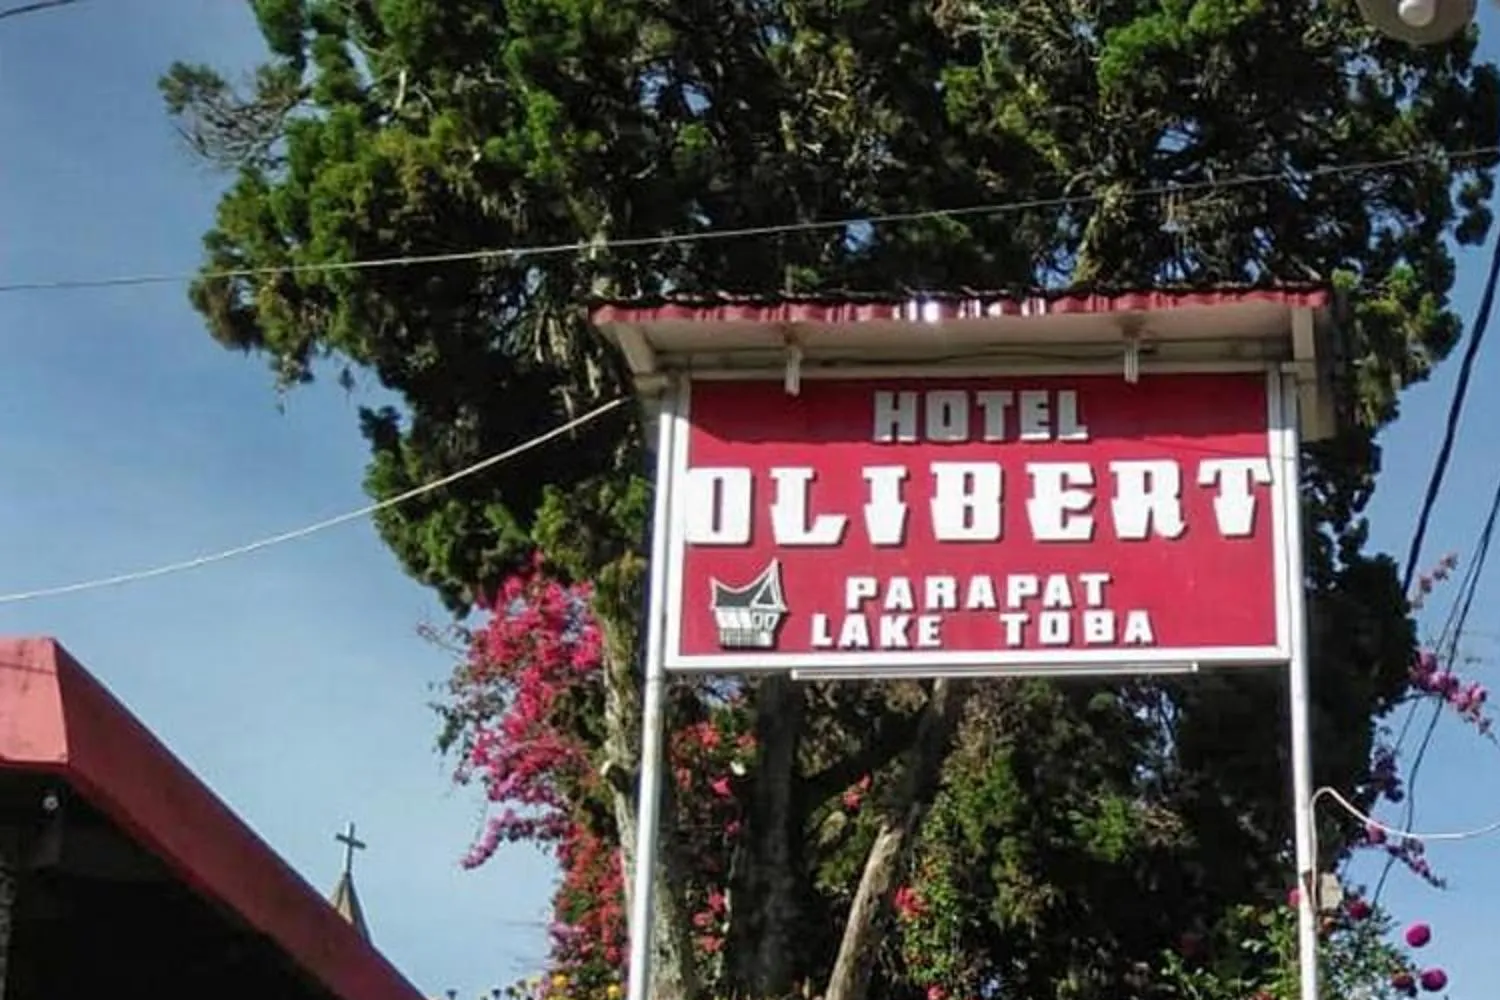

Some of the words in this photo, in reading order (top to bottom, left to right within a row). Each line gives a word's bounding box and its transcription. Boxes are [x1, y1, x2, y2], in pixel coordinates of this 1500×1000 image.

[874, 390, 1088, 442] HOTEL
[685, 459, 1272, 546] OLIBERT
[845, 573, 1111, 610] PARAPAT
[811, 612, 943, 647] LAKE
[1000, 611, 1155, 646] TOBA
